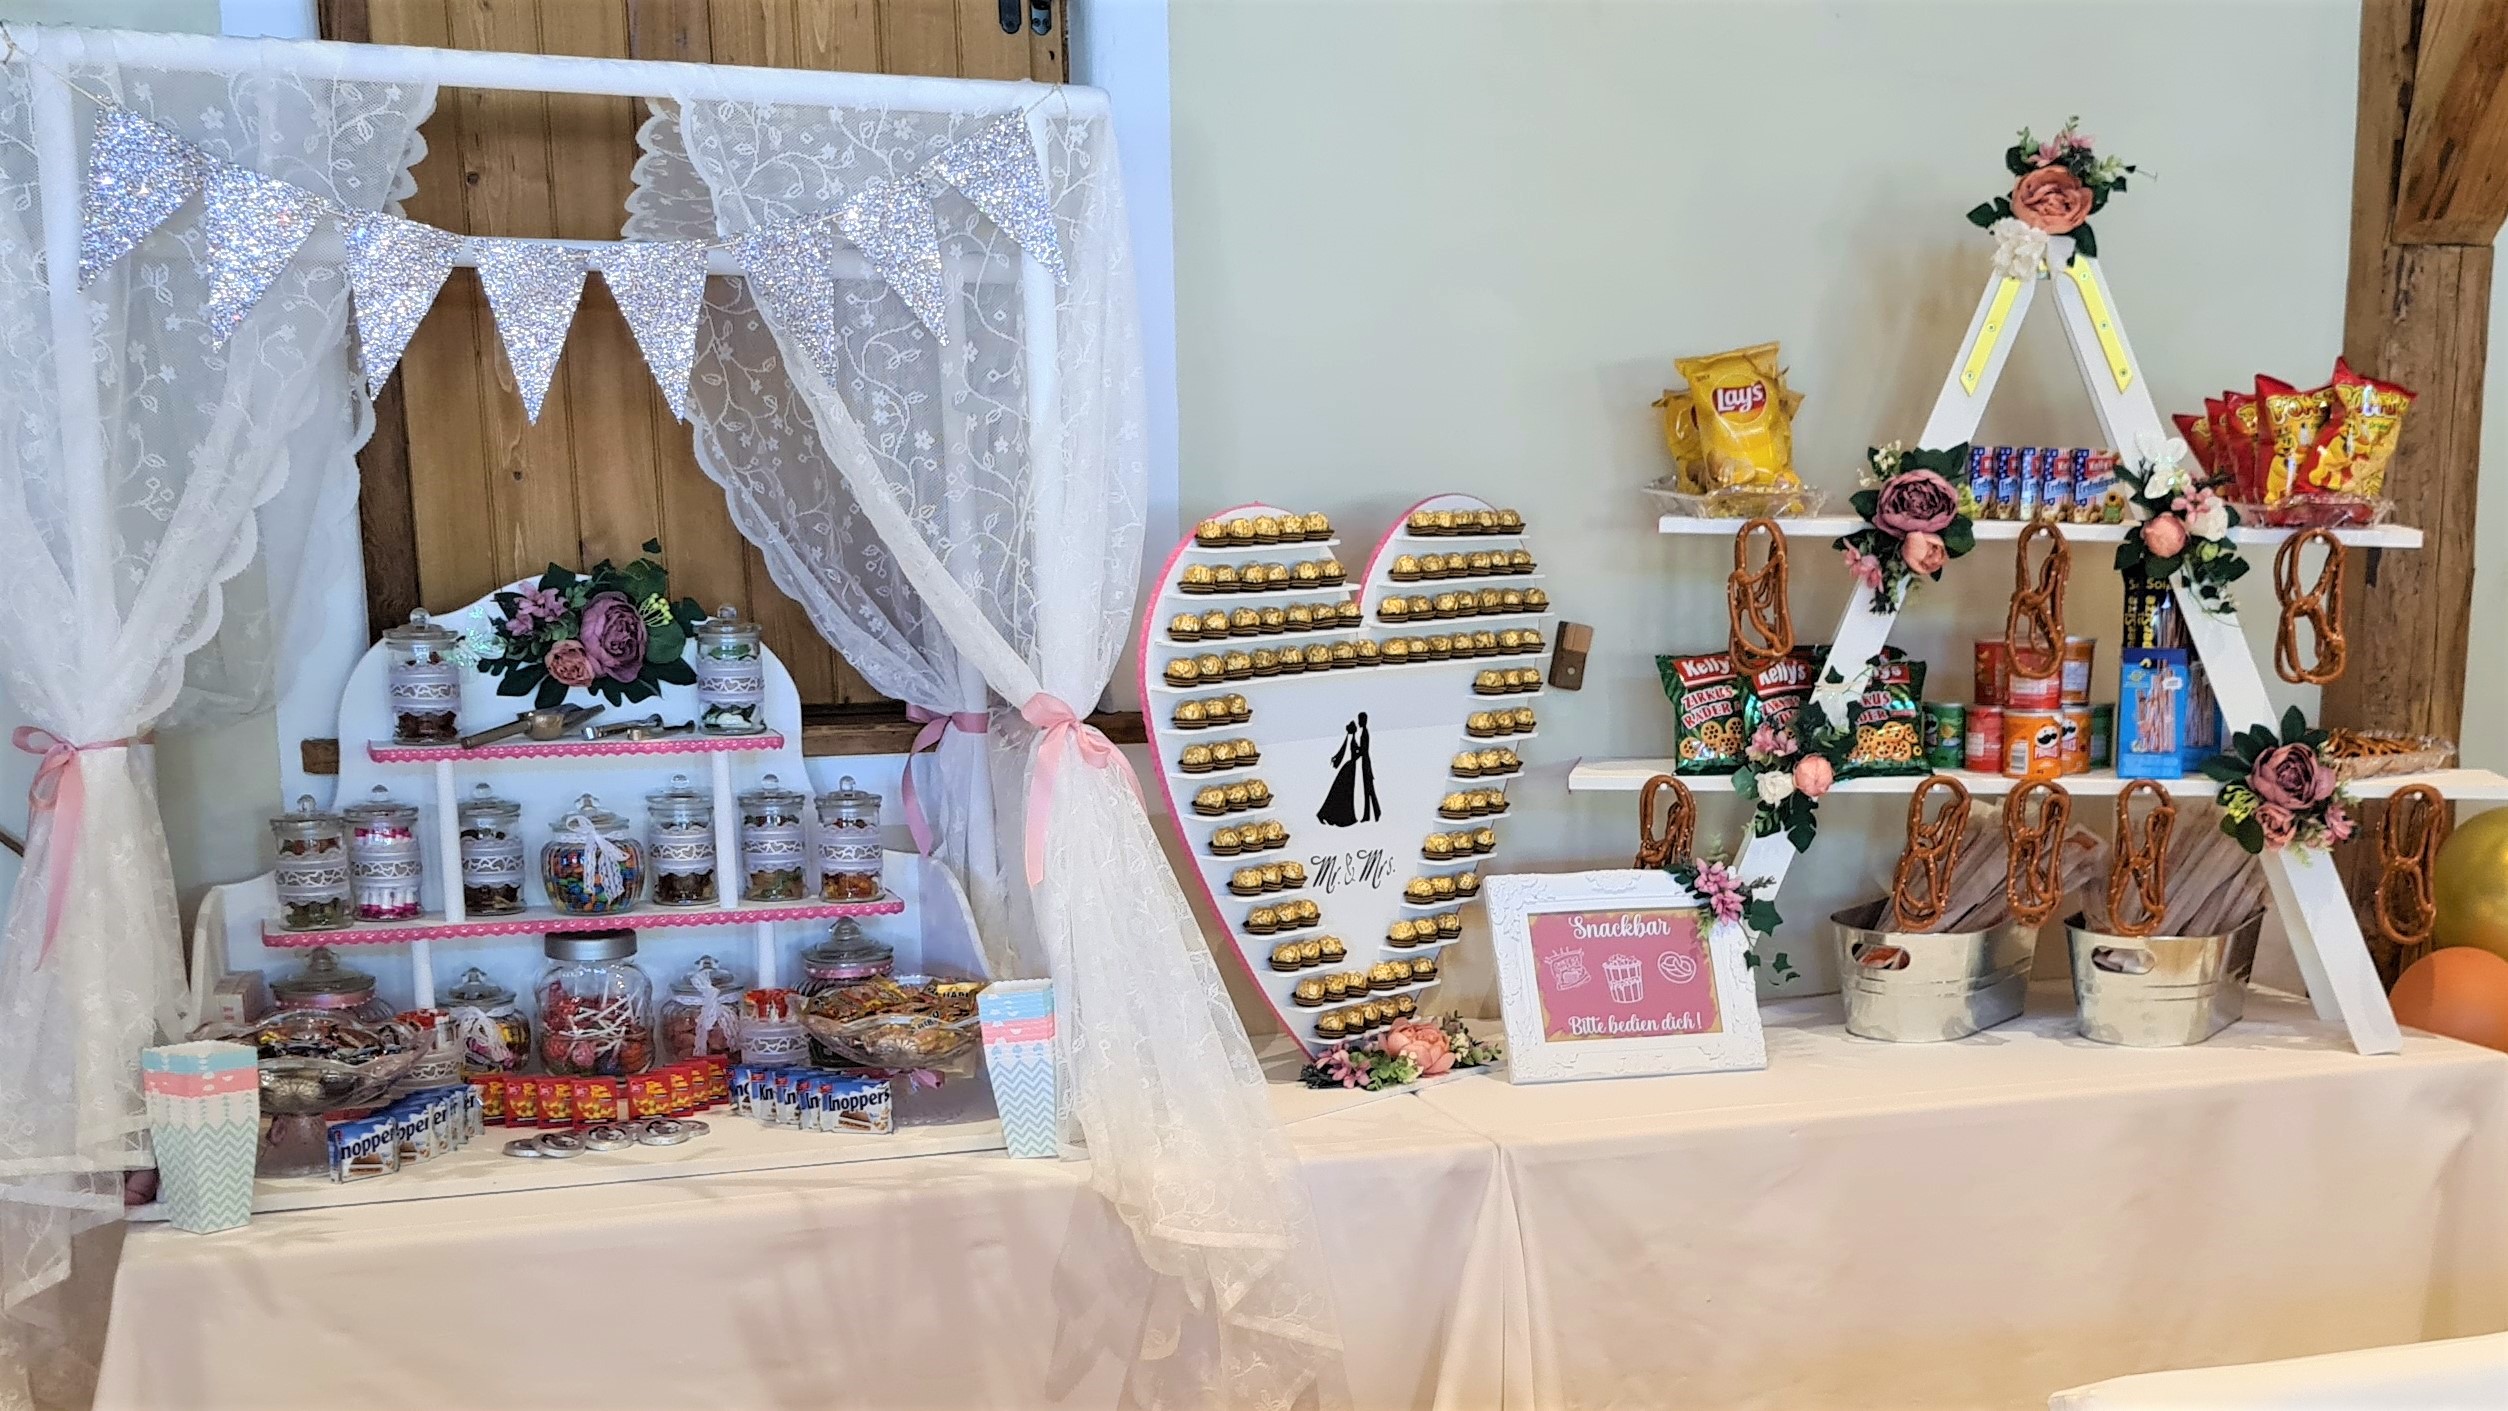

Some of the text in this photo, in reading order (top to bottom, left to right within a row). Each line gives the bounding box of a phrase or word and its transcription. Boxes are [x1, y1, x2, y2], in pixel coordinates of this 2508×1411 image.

[1682, 685, 1734, 709] ZIRKUS
[1862, 692, 1891, 706] KUS
[1344, 852, 1356, 885] &
[1568, 914, 1671, 940] Snackbar
[1568, 1014, 1606, 1036] Bitte
[1608, 1014, 1660, 1033] bedien
[341, 1125, 396, 1159] nopper
